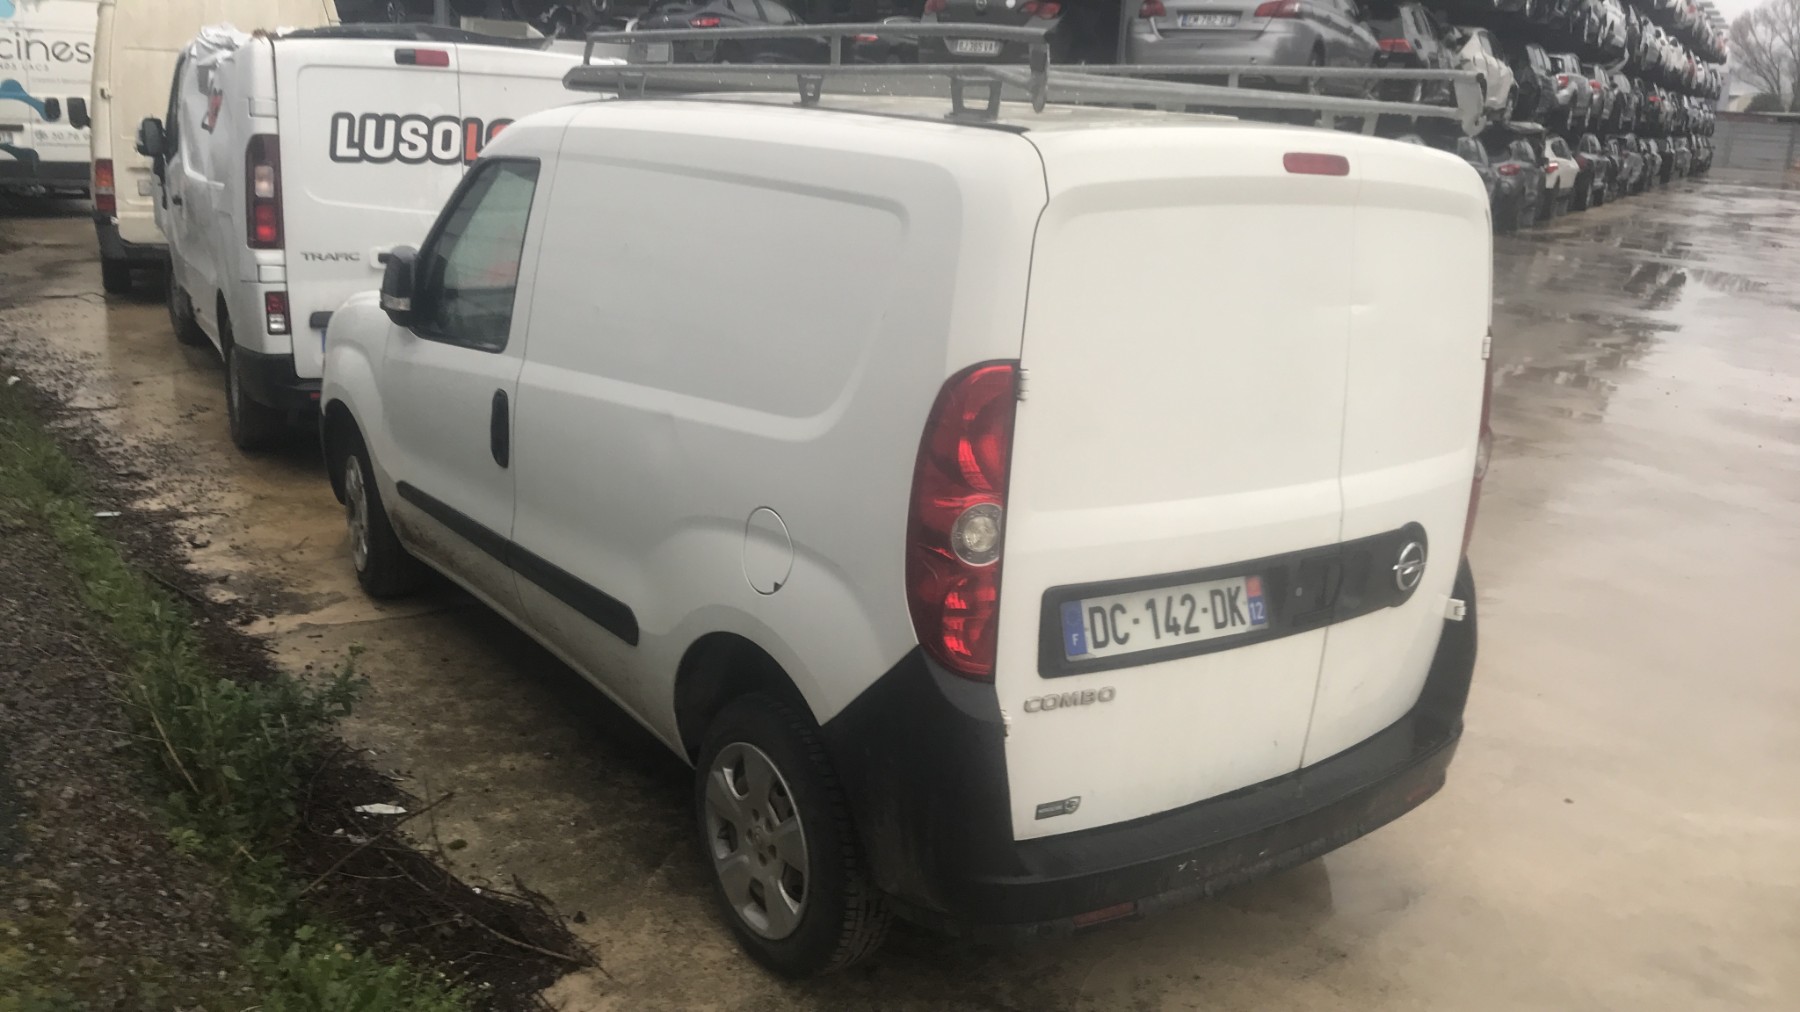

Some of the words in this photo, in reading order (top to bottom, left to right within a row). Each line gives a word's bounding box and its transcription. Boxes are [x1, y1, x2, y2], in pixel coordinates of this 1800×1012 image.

[300, 251, 361, 261] TRAFIC
[1072, 633, 1079, 646] F
[1088, 586, 1246, 649] DC-142-DK
[1250, 602, 1265, 620] 12
[1023, 686, 1116, 713] COMBO
